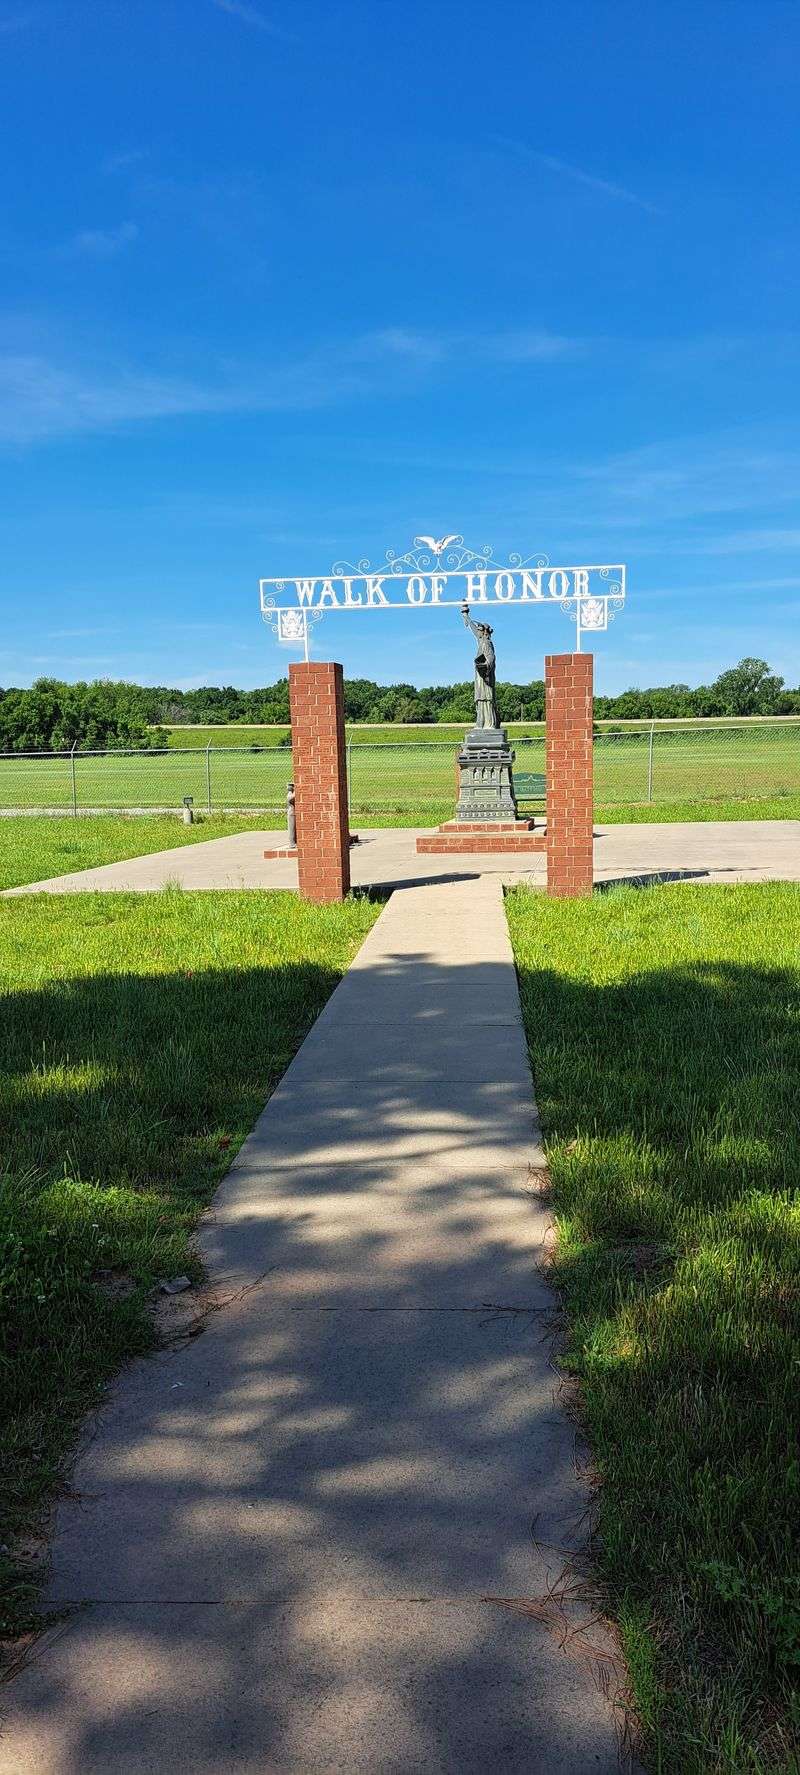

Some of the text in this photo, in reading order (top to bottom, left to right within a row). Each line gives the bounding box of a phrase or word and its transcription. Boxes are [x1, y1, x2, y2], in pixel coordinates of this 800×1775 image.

[295, 569, 593, 607] WALK OF HONOR
